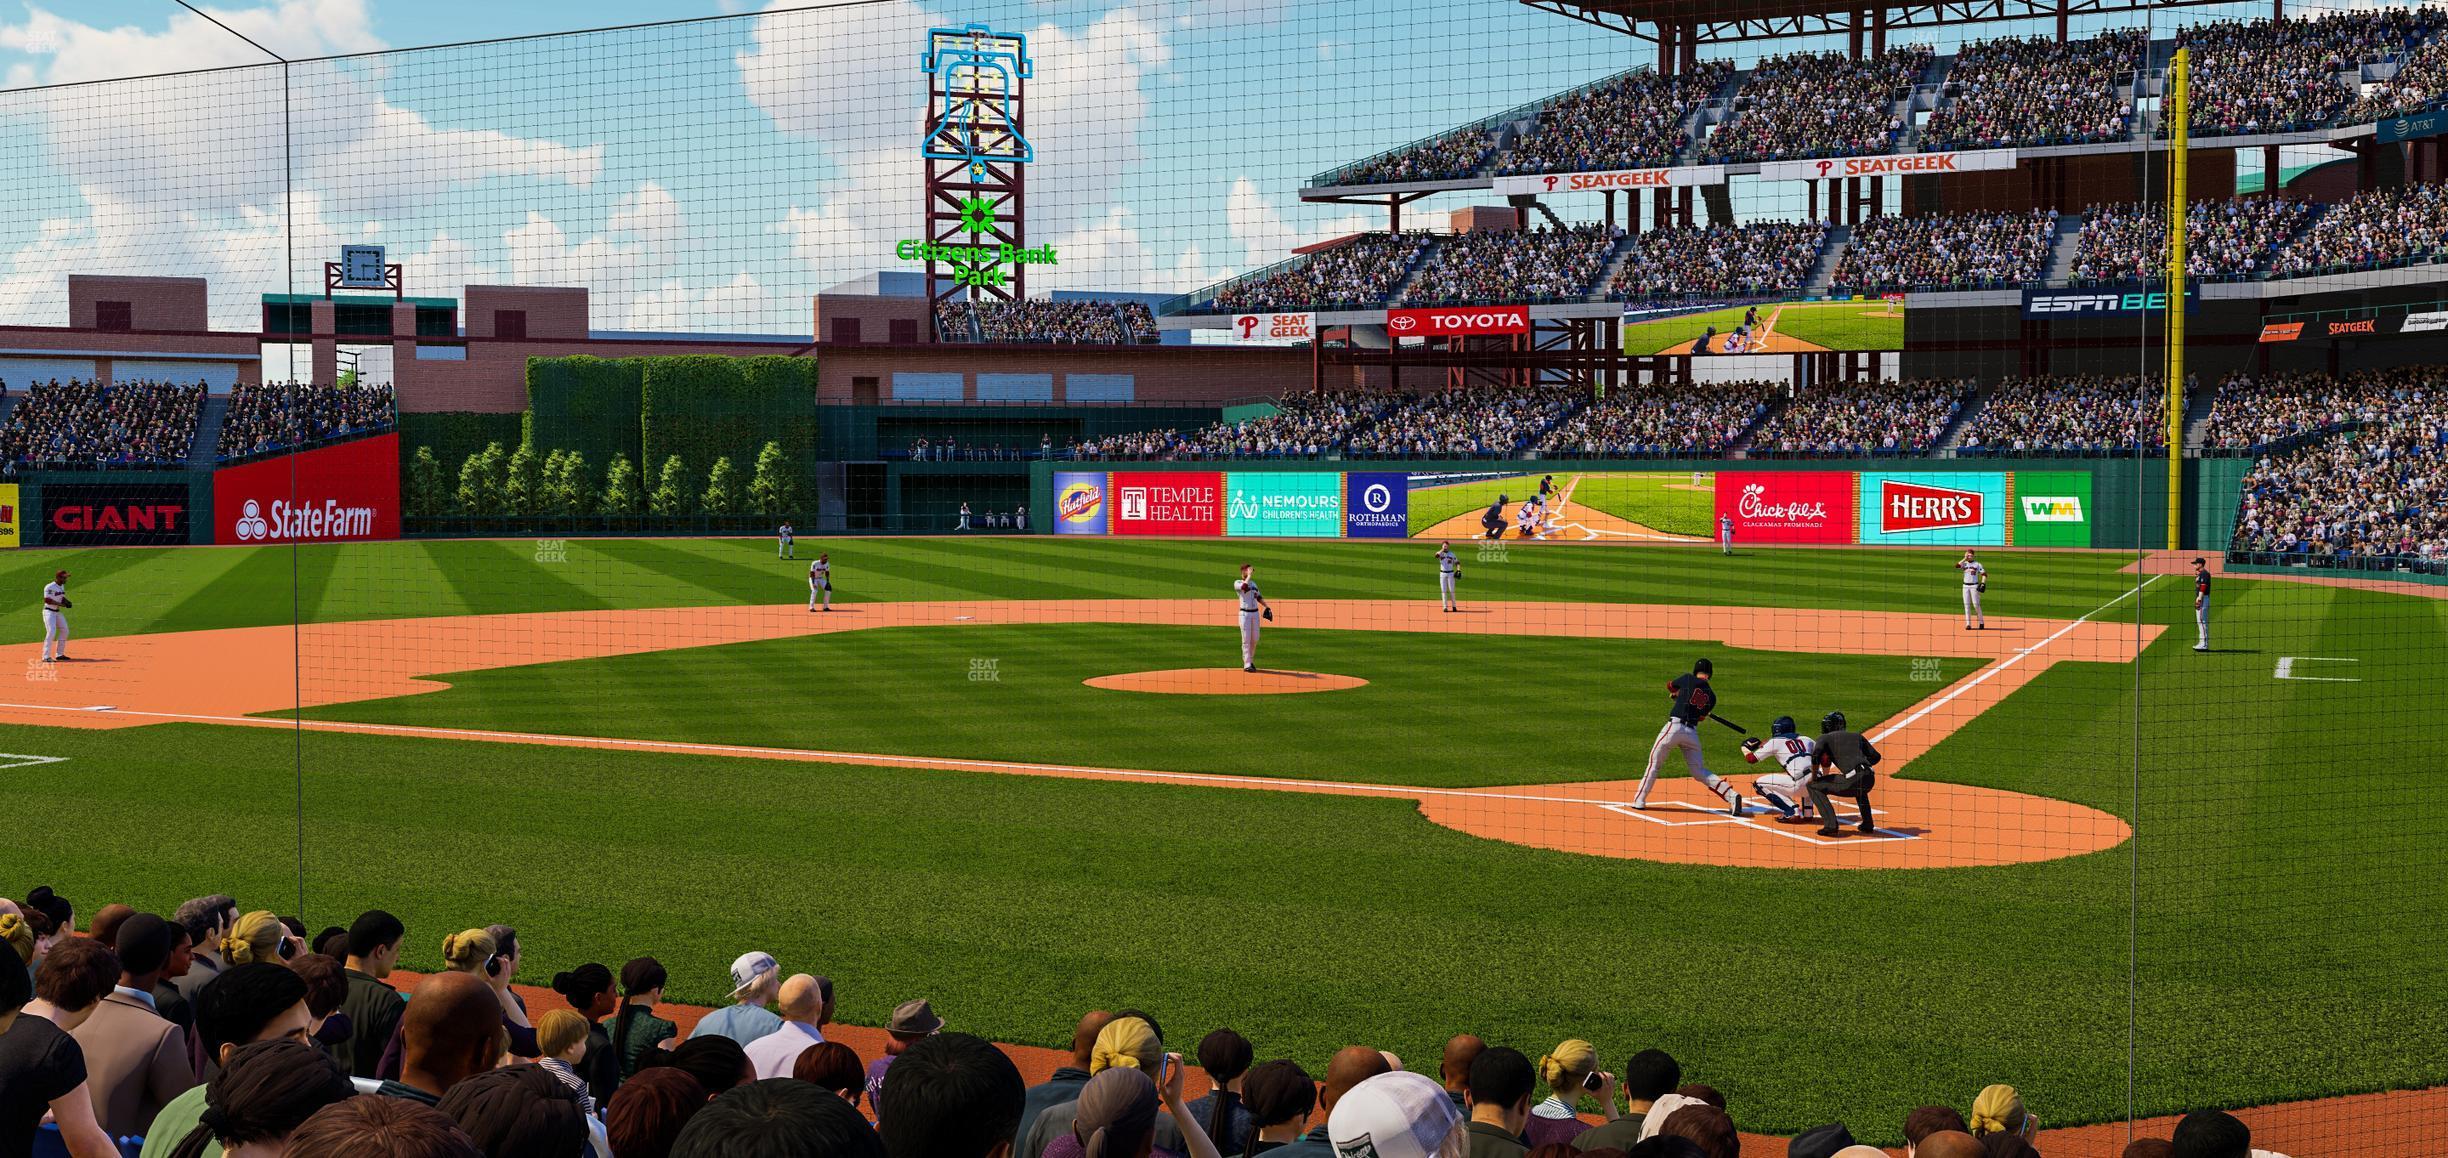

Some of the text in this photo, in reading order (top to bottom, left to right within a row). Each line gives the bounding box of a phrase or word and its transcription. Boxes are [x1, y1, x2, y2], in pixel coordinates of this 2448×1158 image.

[2410, 118, 2435, 131] AT&T
[1815, 160, 1833, 177] P
[1845, 153, 1956, 175] SEATGEEK
[1543, 176, 1559, 192] P
[1570, 169, 1670, 190] SEATGEEK
[896, 239, 1058, 265] Citizens Bank
[954, 265, 1007, 287] Park
[2030, 294, 2119, 312] ESPN
[1237, 315, 1258, 339] P
[1272, 314, 1308, 326] SEAT
[1431, 313, 1525, 329] TOYOTA
[2328, 319, 2375, 335] SEATGEEK
[1270, 325, 1309, 337] GEEK
[1062, 485, 1101, 514] Hatfield
[1150, 487, 1214, 503] TEMPLE
[1262, 495, 1339, 508] NEMOURS
[1739, 486, 1827, 521] Chick-fil-A
[1890, 494, 1971, 521] HERR'S
[2031, 503, 2074, 515] WM
[53, 505, 182, 530] GIANT
[1150, 506, 1214, 521] HEALTH
[1262, 510, 1339, 520] CHILDREN'S HEALTH
[1349, 513, 1406, 522] ROTHMAN
